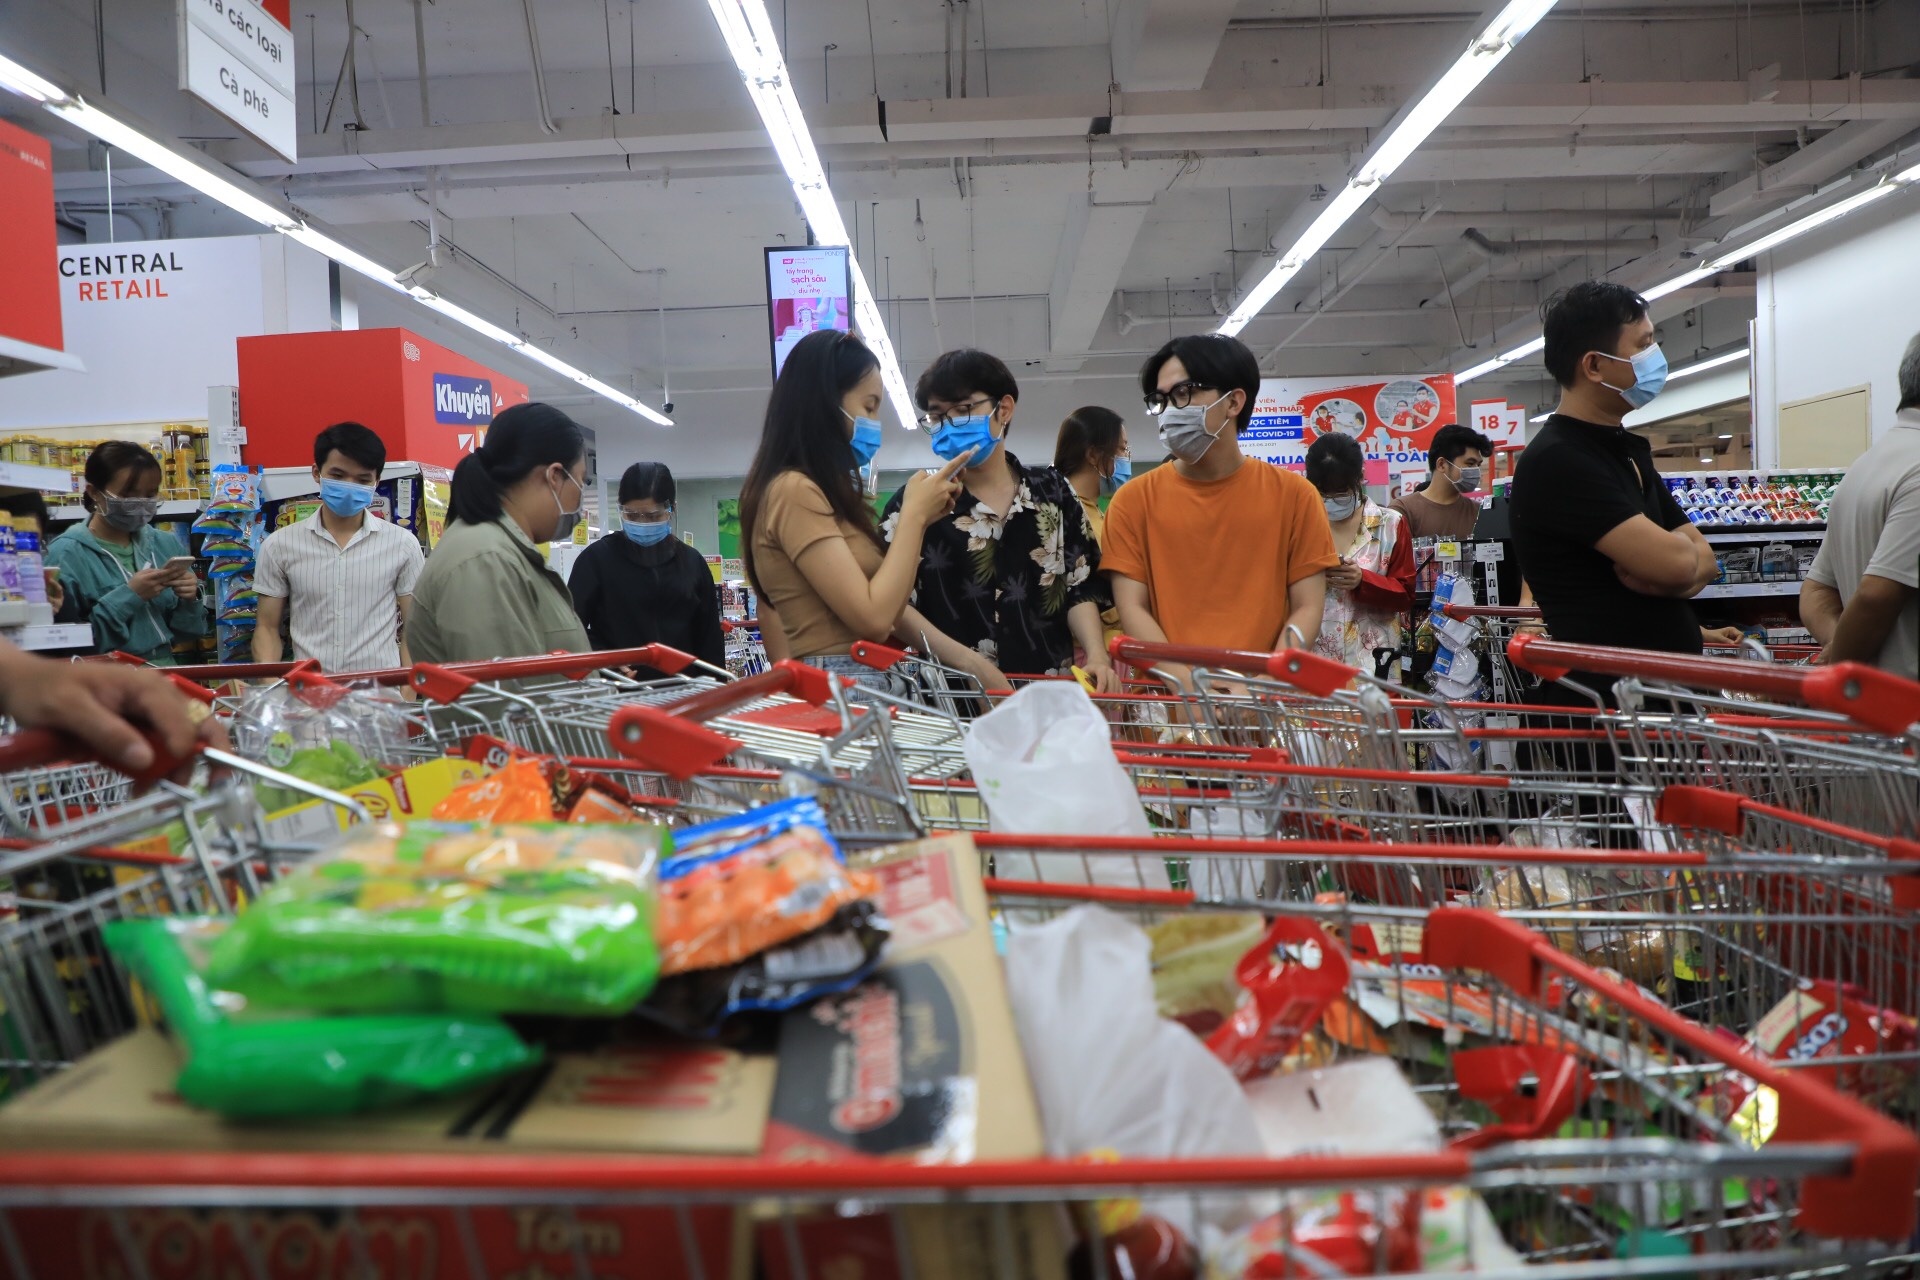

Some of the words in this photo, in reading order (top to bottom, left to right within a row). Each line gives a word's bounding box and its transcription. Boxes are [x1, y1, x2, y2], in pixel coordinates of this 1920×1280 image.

[228, 8, 253, 40] các
[257, 27, 282, 63] loại
[219, 67, 239, 97] Cà
[243, 88, 269, 119] phê
[59, 252, 184, 278] CENTRAL
[791, 275, 809, 285] sạch
[79, 278, 169, 302] RETAIL
[435, 383, 492, 420] Khuyến
[1268, 417, 1290, 425] TIÊM
[1479, 415, 1500, 430] 18
[1507, 421, 1517, 435] 7
[1255, 430, 1296, 438] COVID-19
